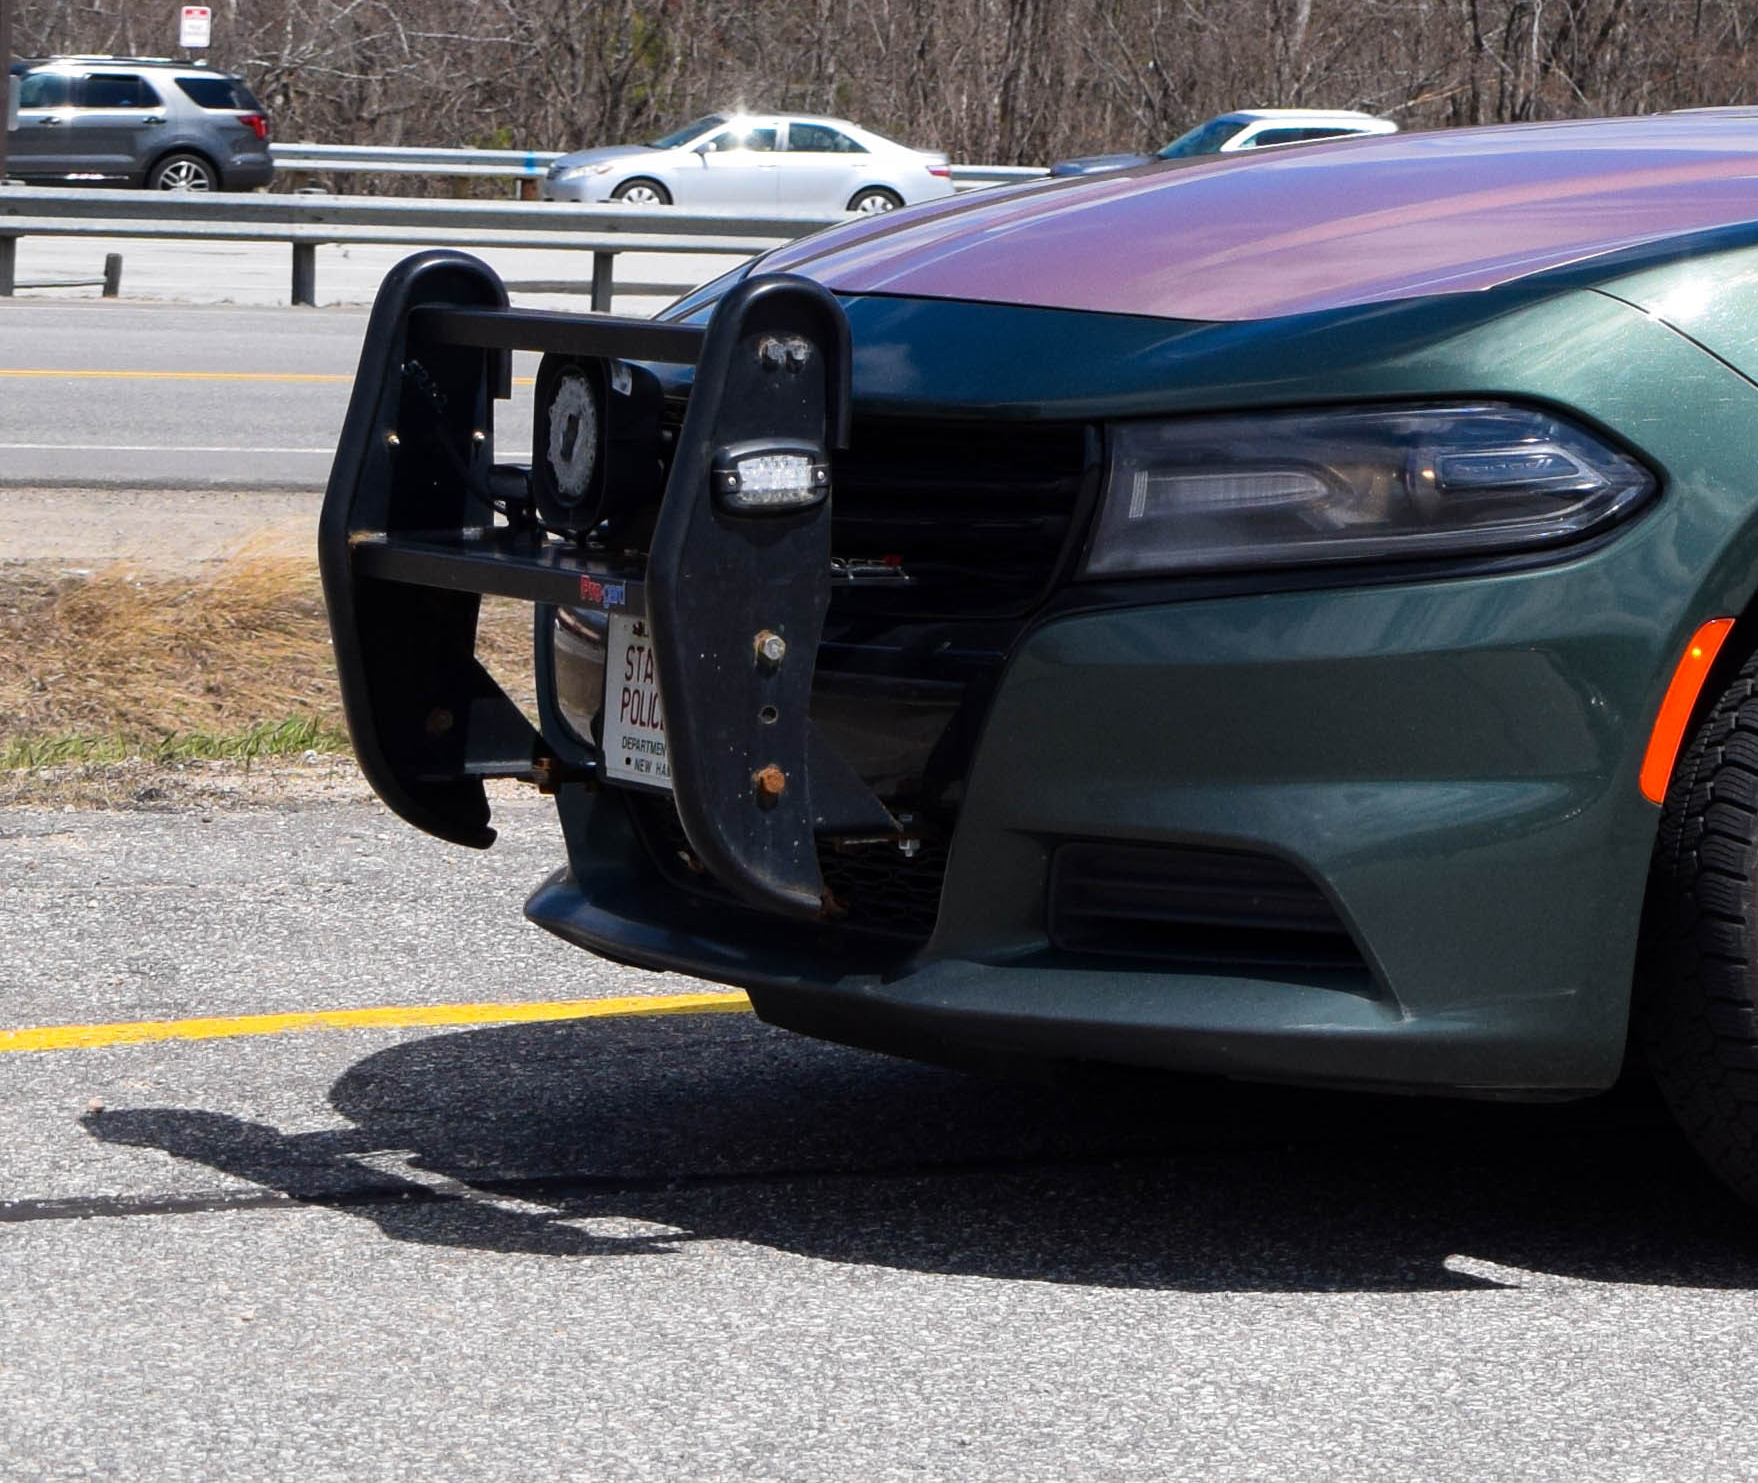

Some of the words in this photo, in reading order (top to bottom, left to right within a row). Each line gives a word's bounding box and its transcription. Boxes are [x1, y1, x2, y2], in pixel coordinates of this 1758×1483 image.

[624, 644, 655, 685] STA
[621, 735, 667, 757] DEPARTMEN
[633, 758, 652, 774] NEW
